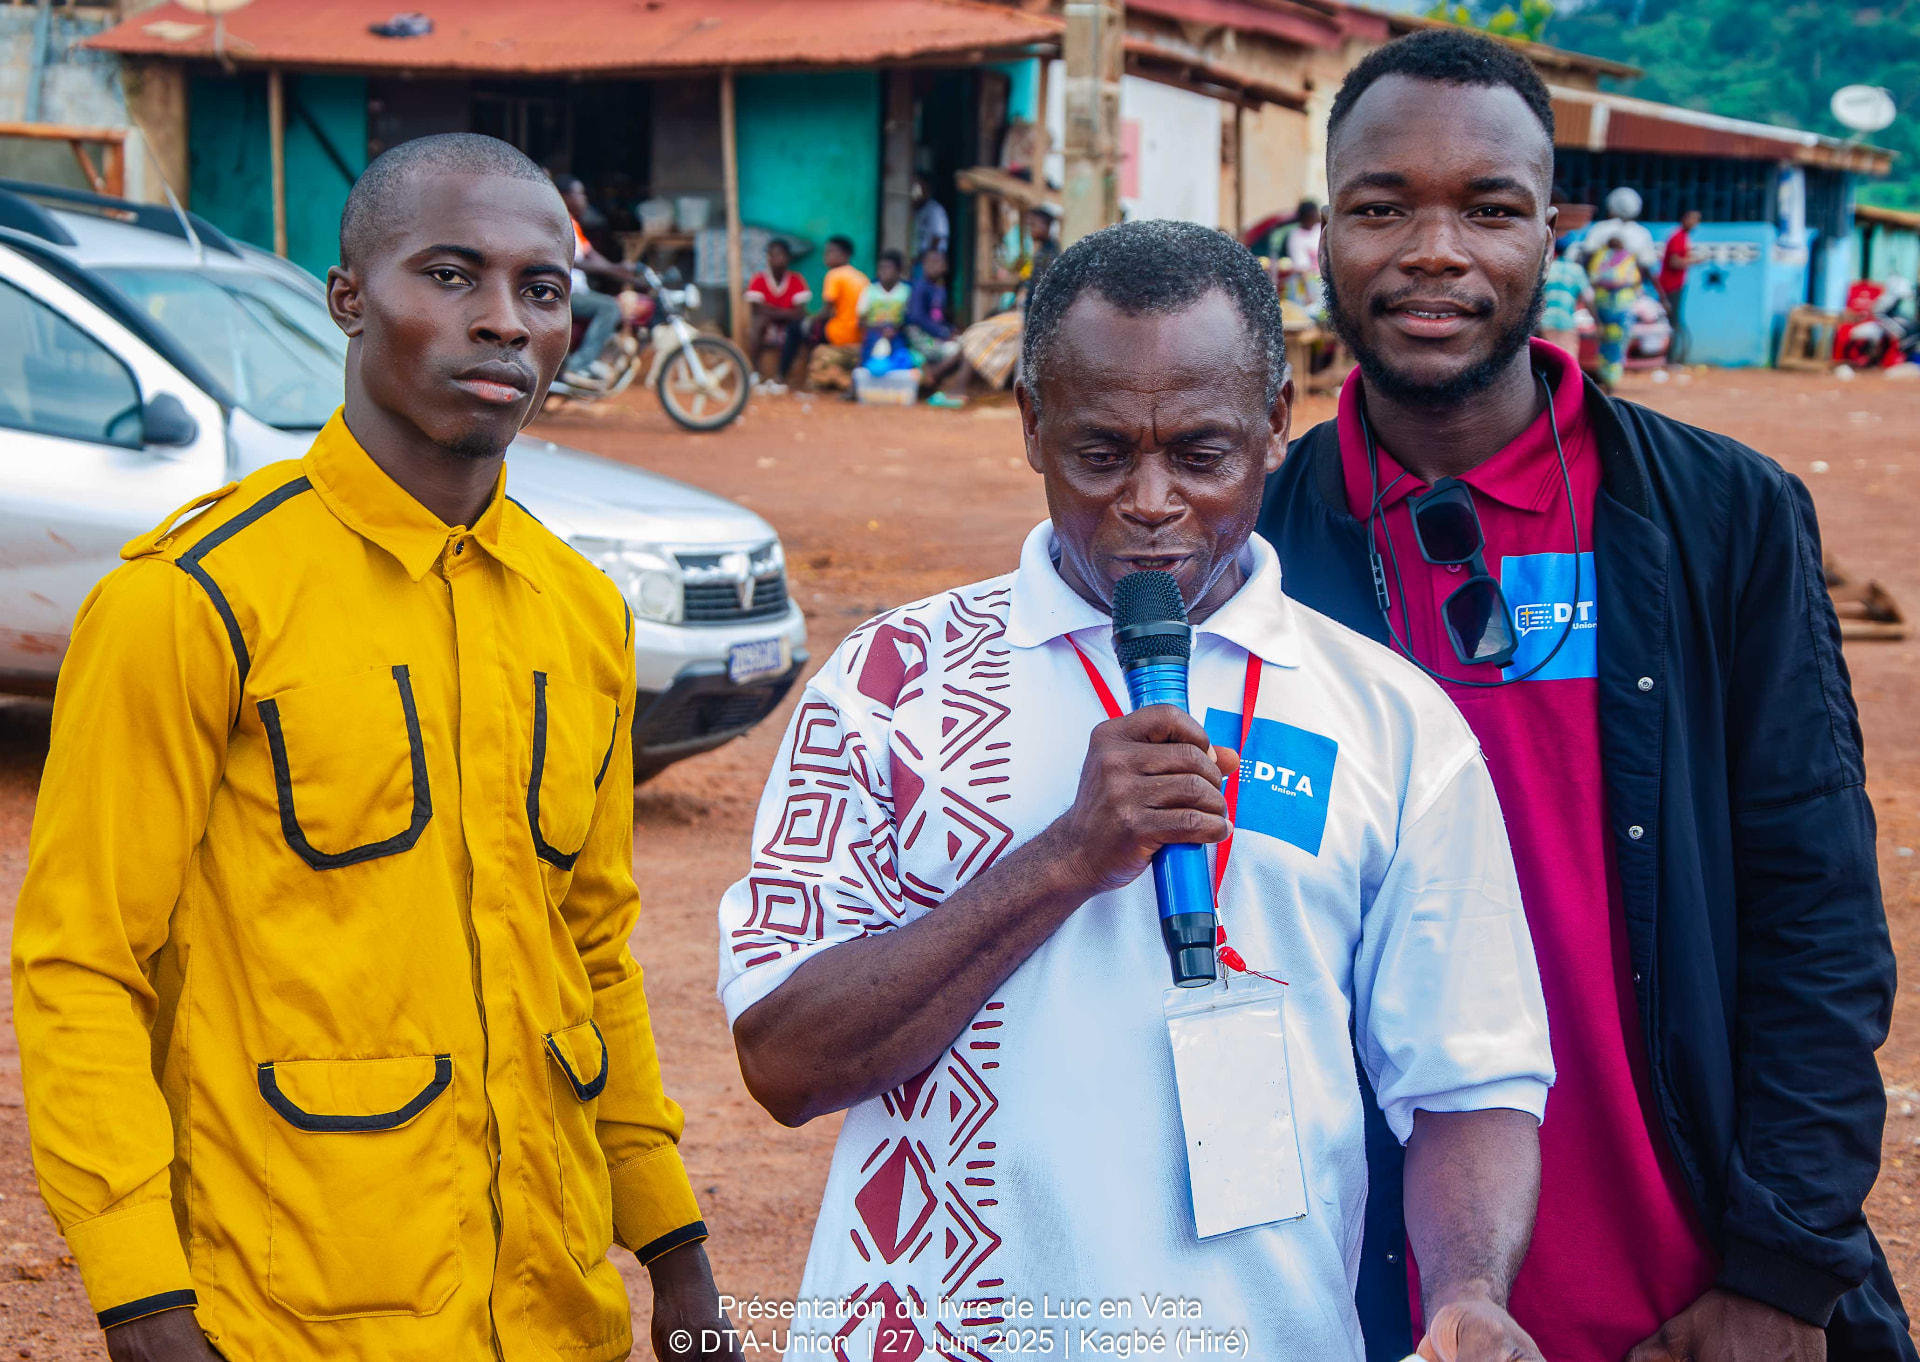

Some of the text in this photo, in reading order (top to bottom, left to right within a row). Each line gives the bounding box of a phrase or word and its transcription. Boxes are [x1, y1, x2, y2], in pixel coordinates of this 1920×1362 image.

[1554, 601, 1597, 622] DT
[1253, 760, 1313, 797] DTA
[1271, 784, 1297, 797] Union
